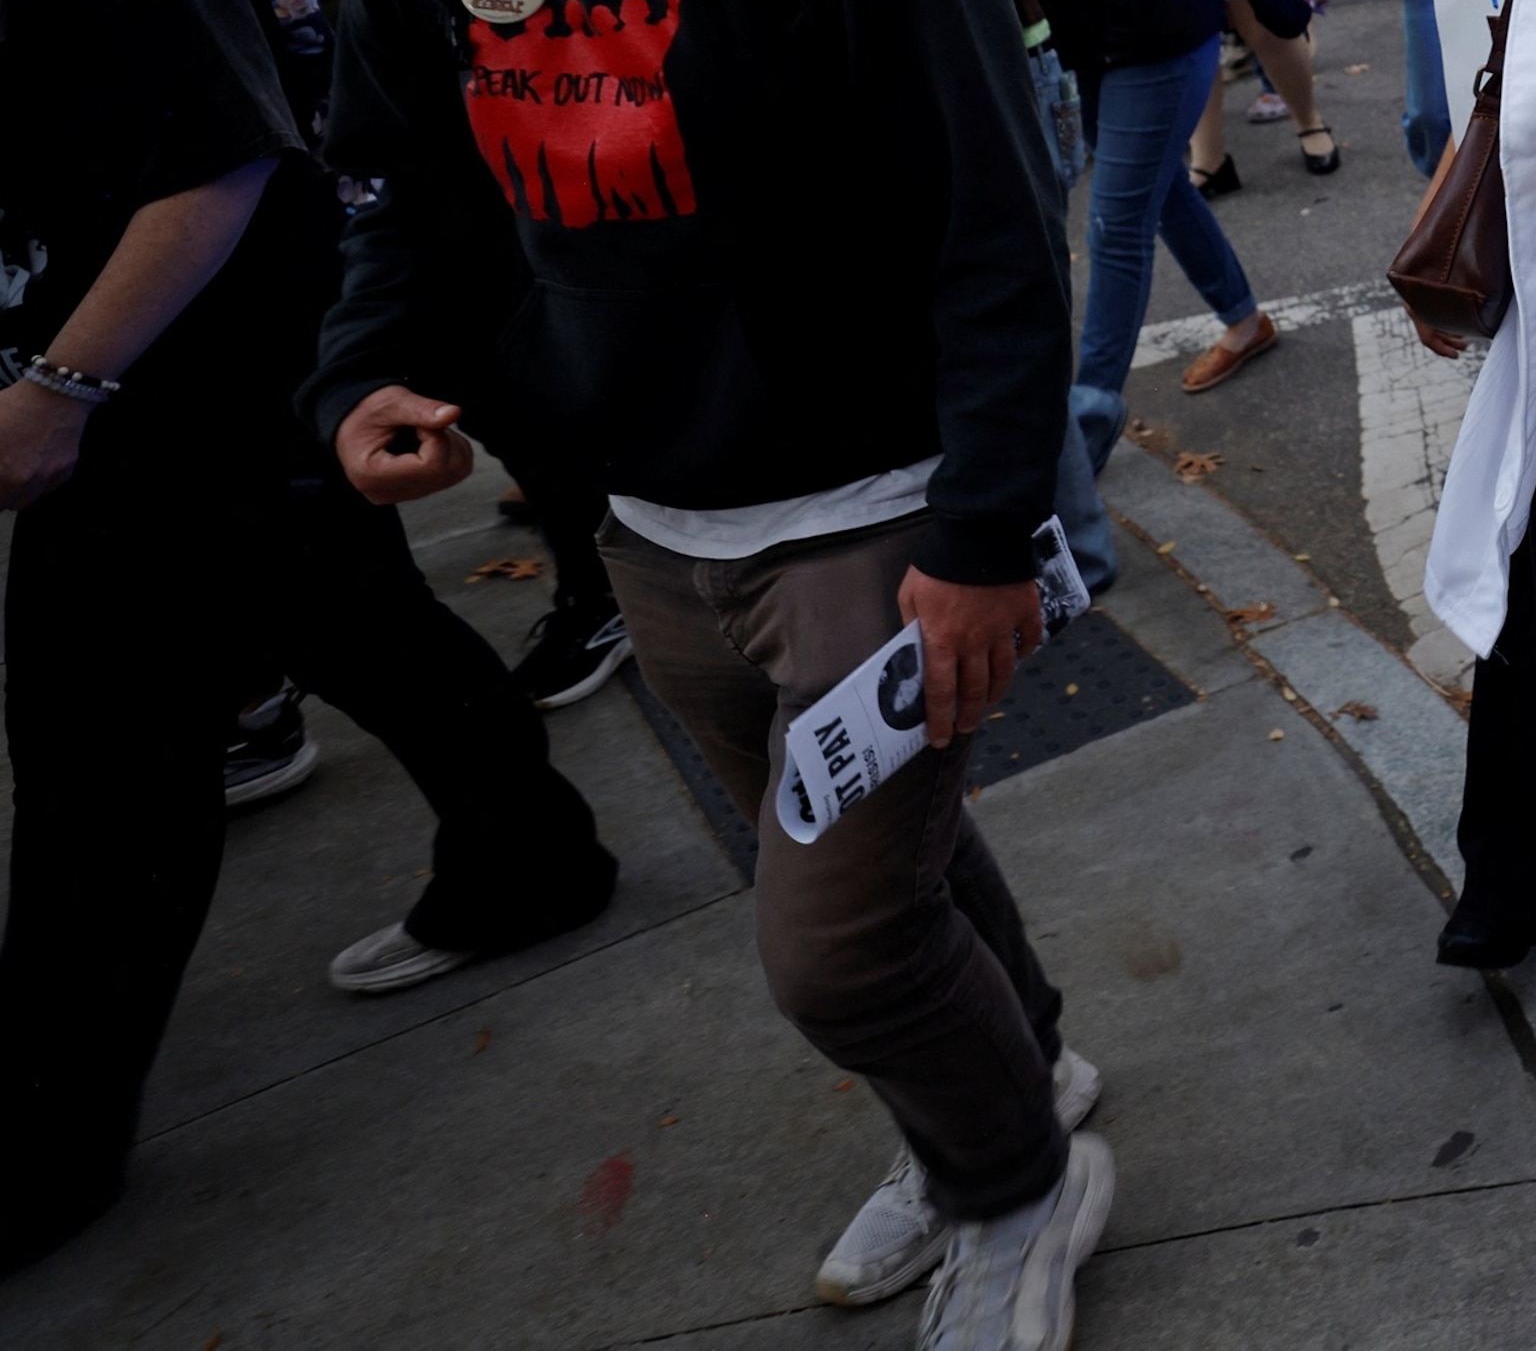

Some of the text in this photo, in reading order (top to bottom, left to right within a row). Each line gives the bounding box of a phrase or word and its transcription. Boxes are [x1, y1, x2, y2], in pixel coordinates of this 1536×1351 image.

[554, 71, 610, 106] OUT
[615, 72, 664, 107] NOW
[814, 716, 856, 779] PAY
